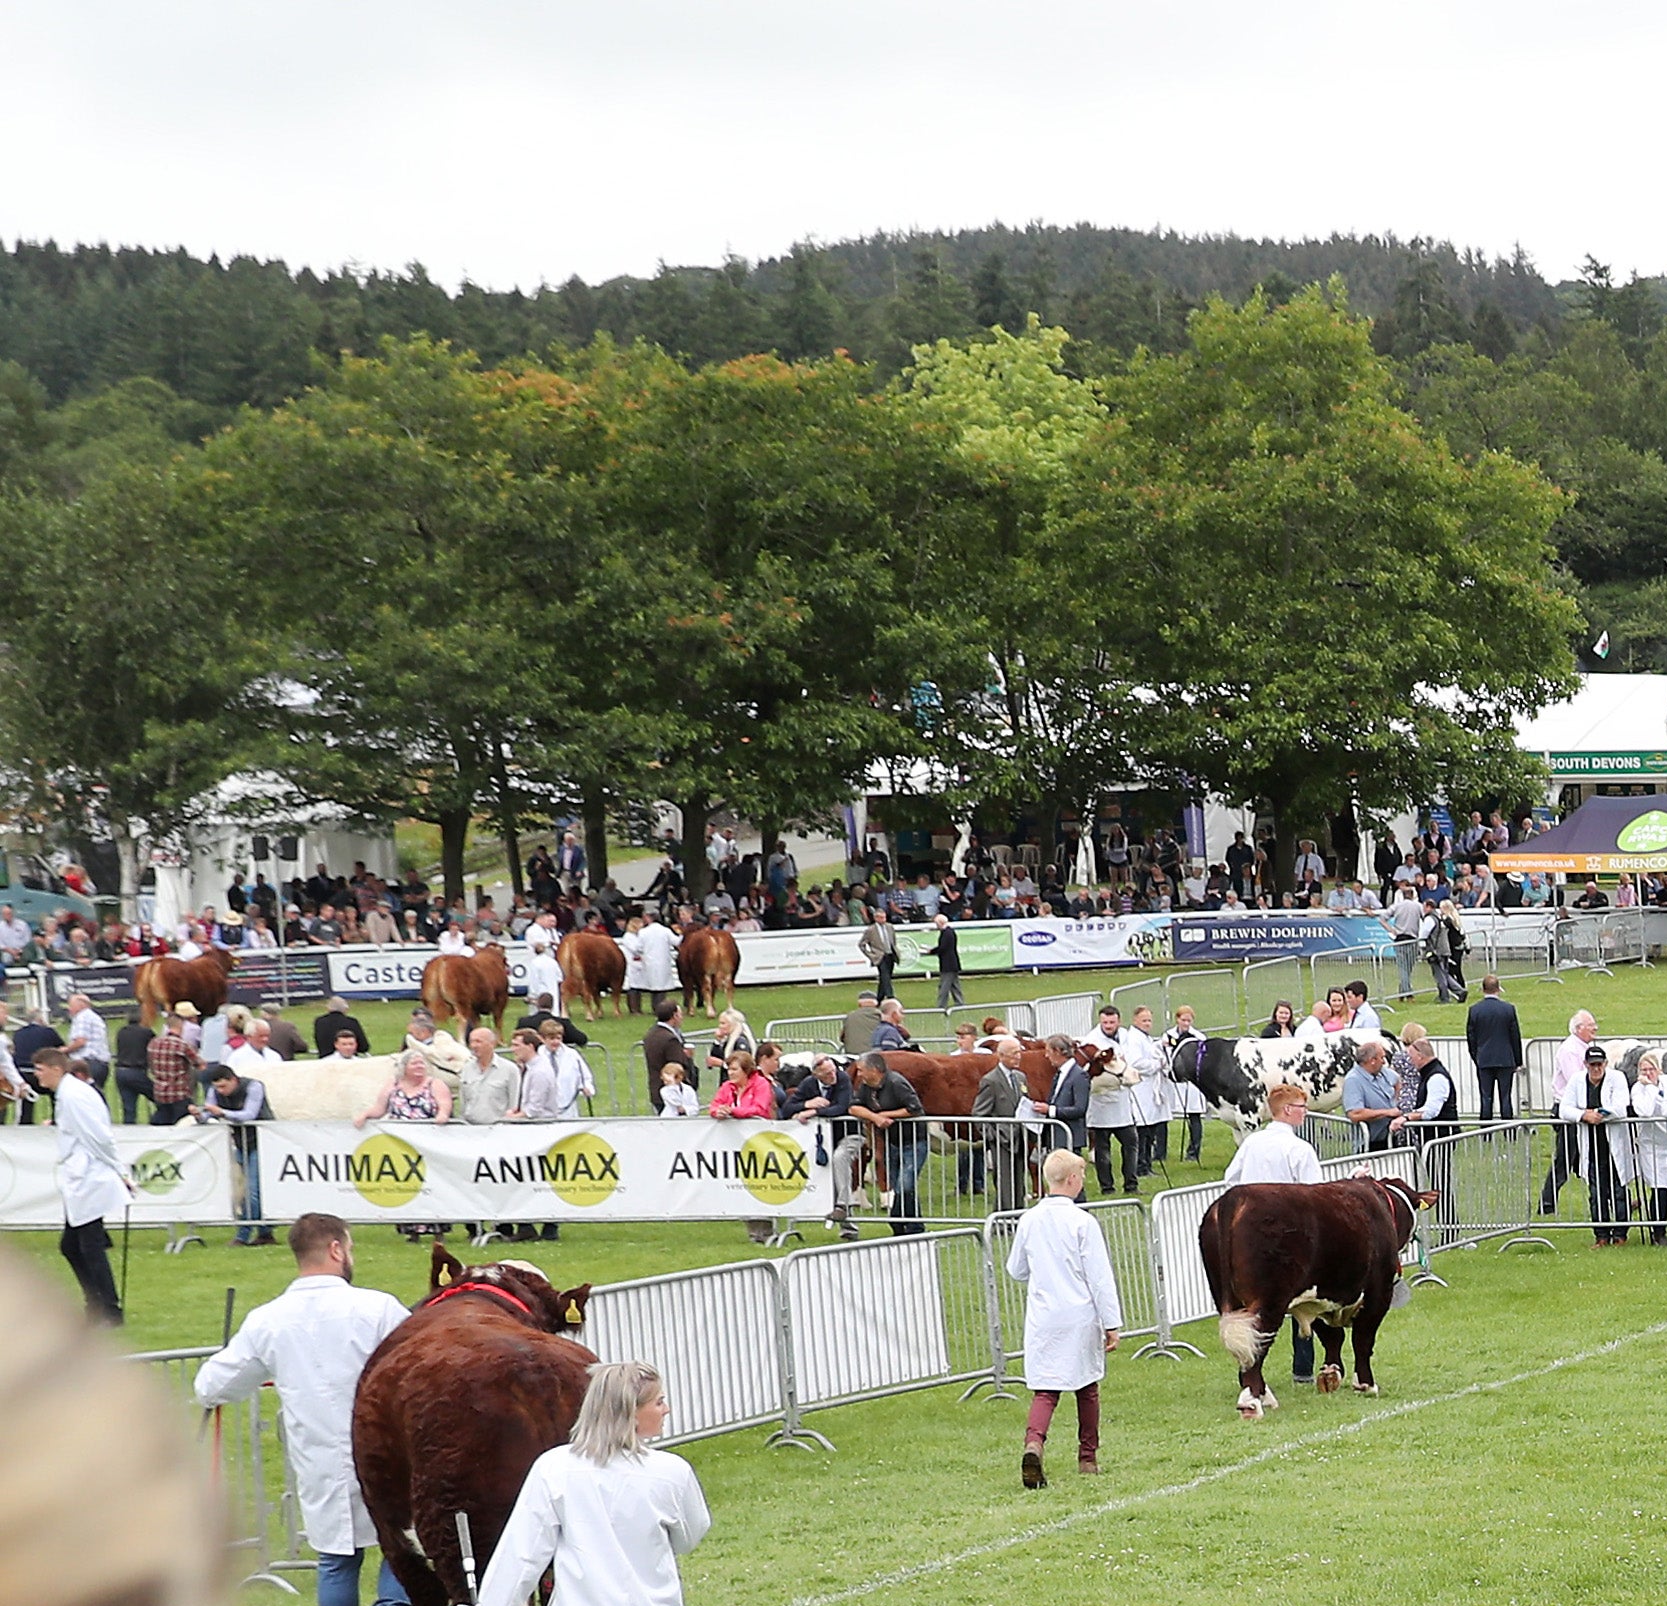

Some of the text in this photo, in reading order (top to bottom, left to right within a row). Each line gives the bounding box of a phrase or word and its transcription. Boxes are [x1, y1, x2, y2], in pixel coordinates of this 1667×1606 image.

[1550, 757, 1589, 770] SOUTH
[1592, 756, 1641, 769] DEVONS
[1608, 856, 1667, 869] RUMENCO
[1211, 927, 1333, 939] BREWIN DOLPHIN
[279, 1153, 427, 1184] ANIMAX
[473, 1152, 621, 1184] ANIMAX
[669, 1150, 811, 1180] ANIMAX
